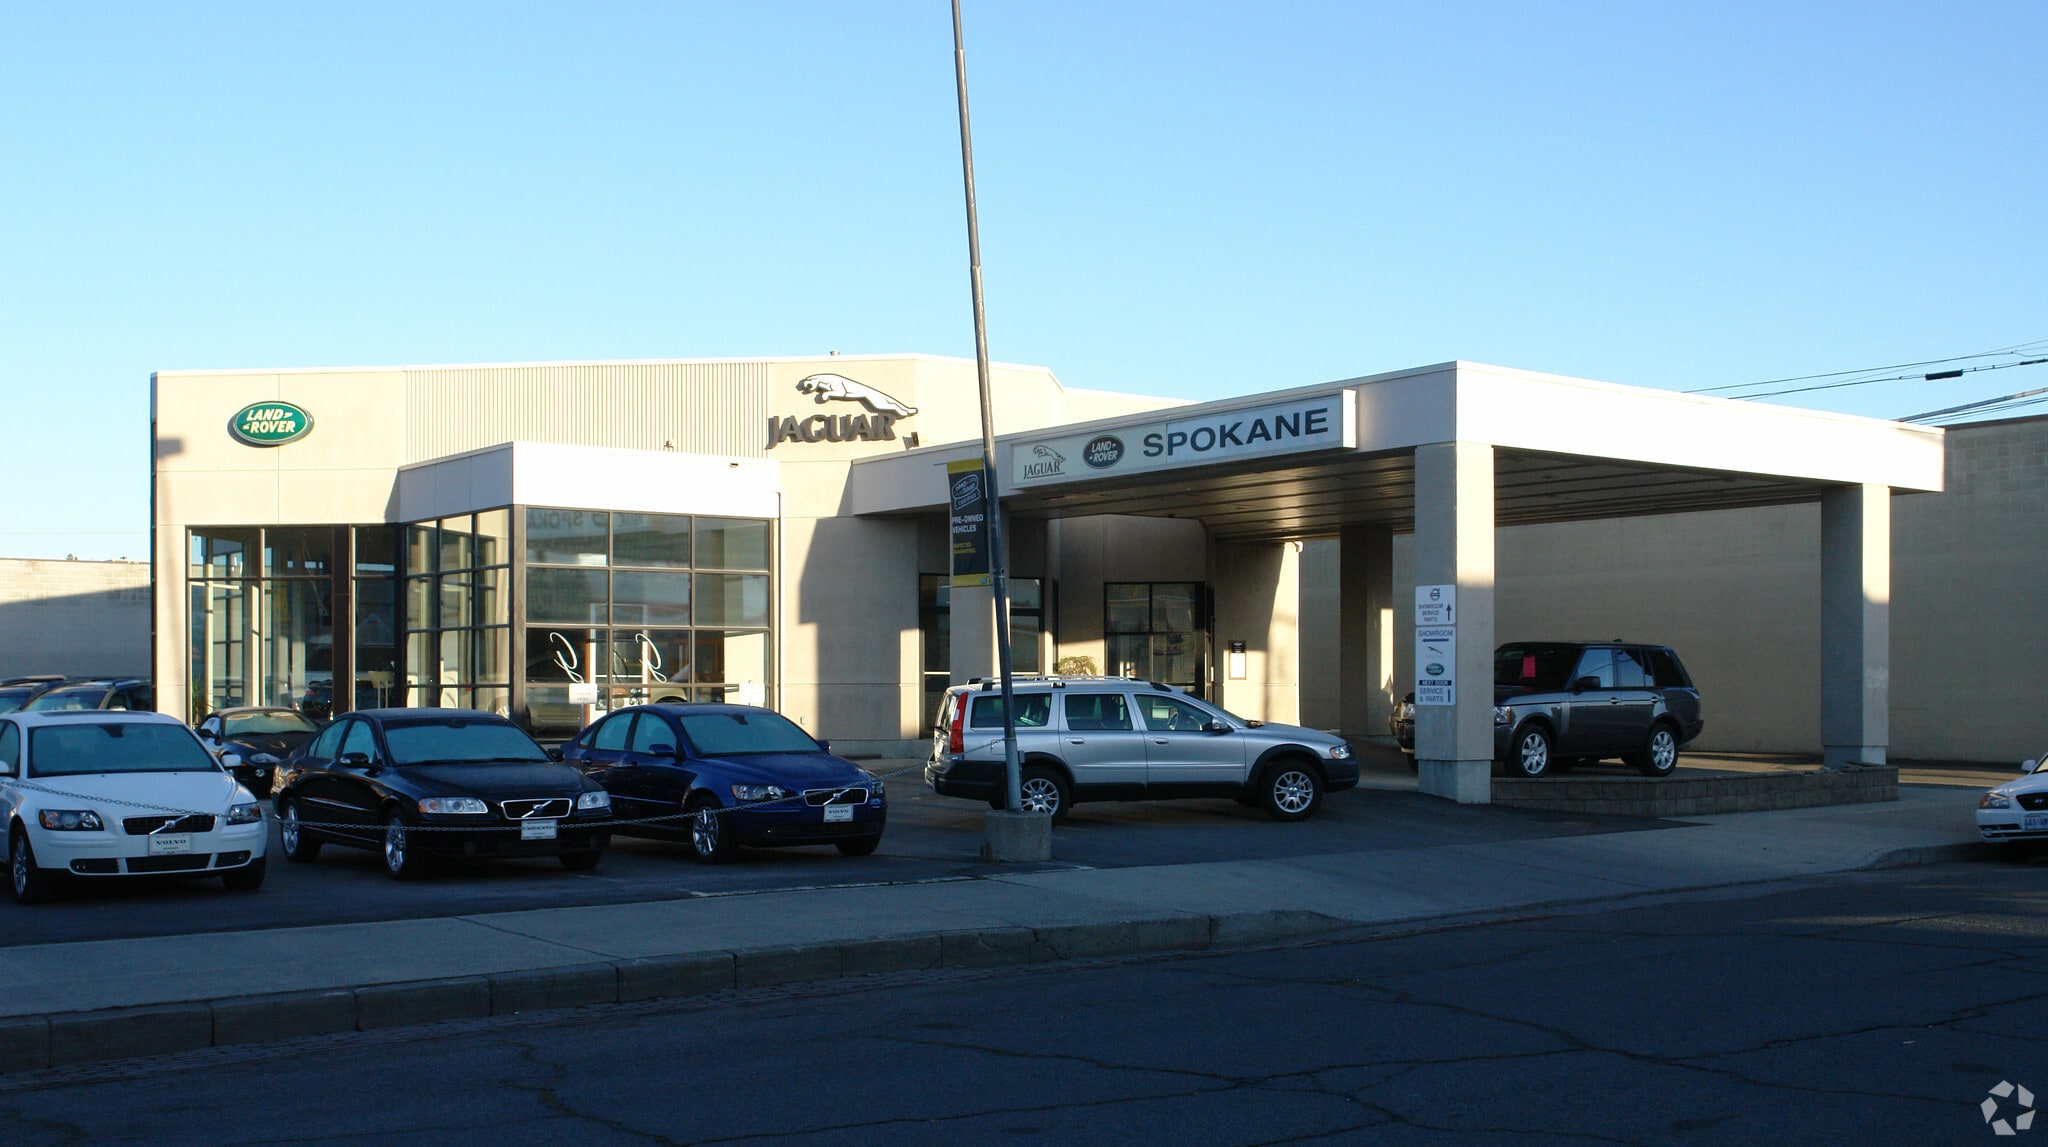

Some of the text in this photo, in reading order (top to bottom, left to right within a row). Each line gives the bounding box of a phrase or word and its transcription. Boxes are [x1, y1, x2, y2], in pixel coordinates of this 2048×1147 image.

[246, 408, 284, 421] LAND
[250, 420, 296, 433] ROVER
[765, 413, 896, 450] JAGUAR
[1143, 407, 1329, 457] SPOKANE
[1091, 441, 1113, 453] LAND
[1092, 449, 1118, 463] ROVER
[1023, 460, 1061, 480] JAGUAR
[1425, 695, 1445, 703] PARTS
